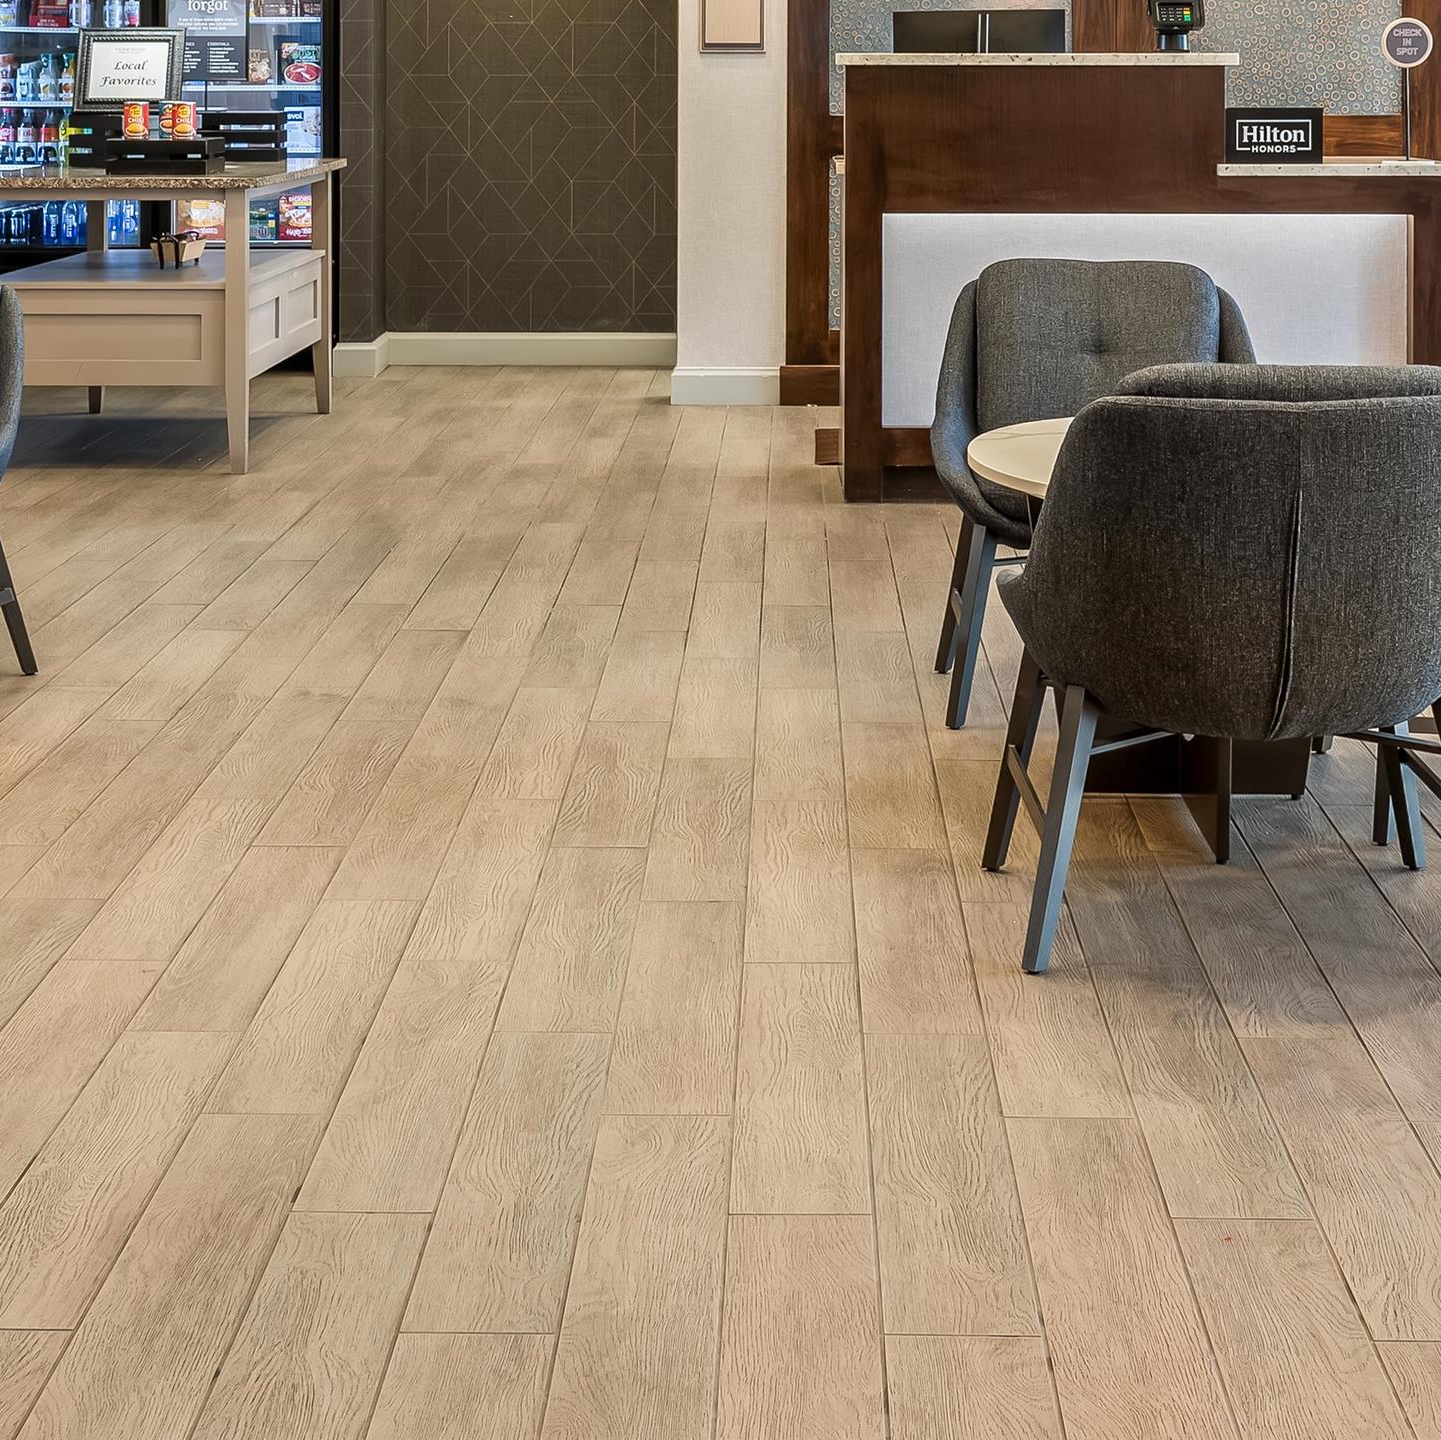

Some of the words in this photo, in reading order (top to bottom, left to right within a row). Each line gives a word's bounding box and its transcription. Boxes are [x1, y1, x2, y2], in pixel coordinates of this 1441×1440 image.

[1393, 28, 1422, 37] CHECK
[1402, 38, 1412, 46] IN
[1396, 48, 1418, 56] SPOT
[114, 59, 148, 70] Local
[99, 76, 158, 87] Favorites
[1242, 126, 1306, 143] Hilton
[1251, 145, 1296, 153] HONORS
